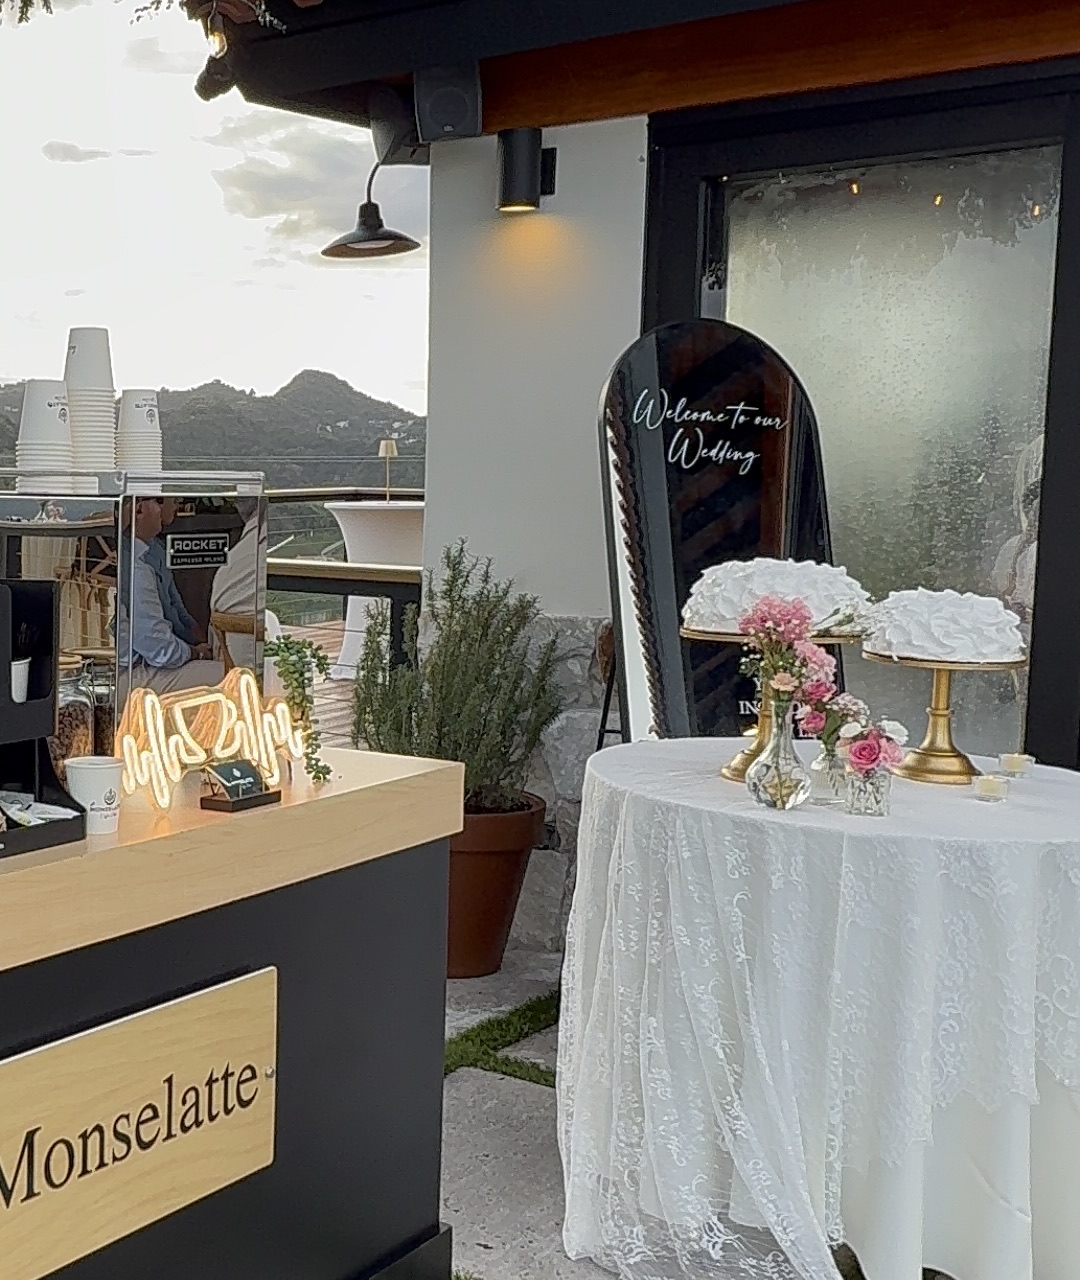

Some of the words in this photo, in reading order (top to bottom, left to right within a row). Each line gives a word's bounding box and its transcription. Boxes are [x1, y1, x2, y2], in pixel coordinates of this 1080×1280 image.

[633, 388, 728, 429] Welcome
[725, 401, 759, 429] to
[754, 417, 790, 430] our
[668, 427, 761, 475] Wedding
[174, 539, 225, 551] ROCKET
